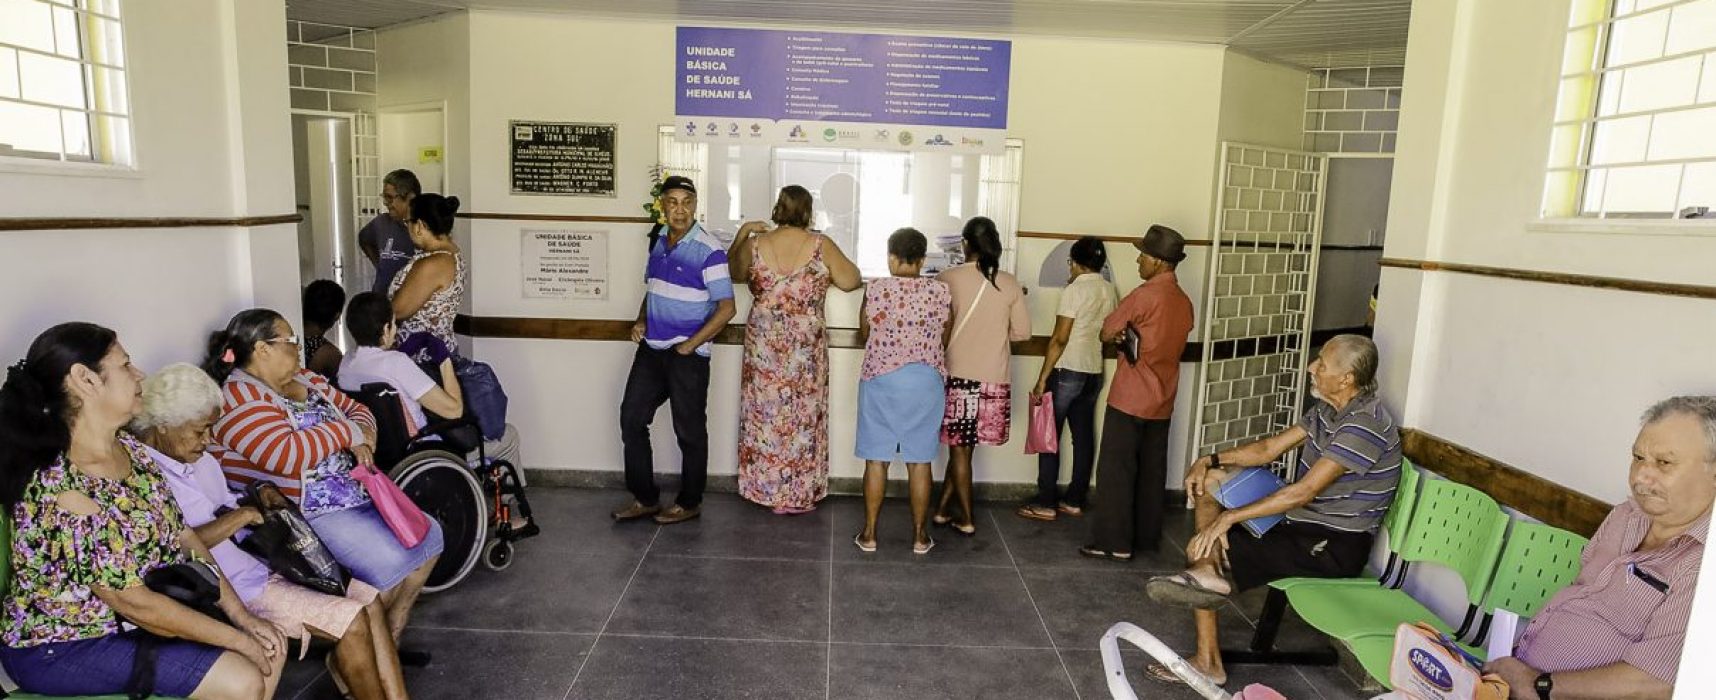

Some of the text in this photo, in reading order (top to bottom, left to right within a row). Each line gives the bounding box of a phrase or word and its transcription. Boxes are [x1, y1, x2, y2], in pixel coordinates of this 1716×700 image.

[686, 46, 735, 57] UNIDADE
[686, 59, 727, 71] BÁSICA
[686, 73, 741, 86] DE SAÚDE
[686, 88, 753, 100] HERNANI SÁ
[533, 125, 560, 134] CENTRO
[535, 233, 566, 241] UNIDADE
